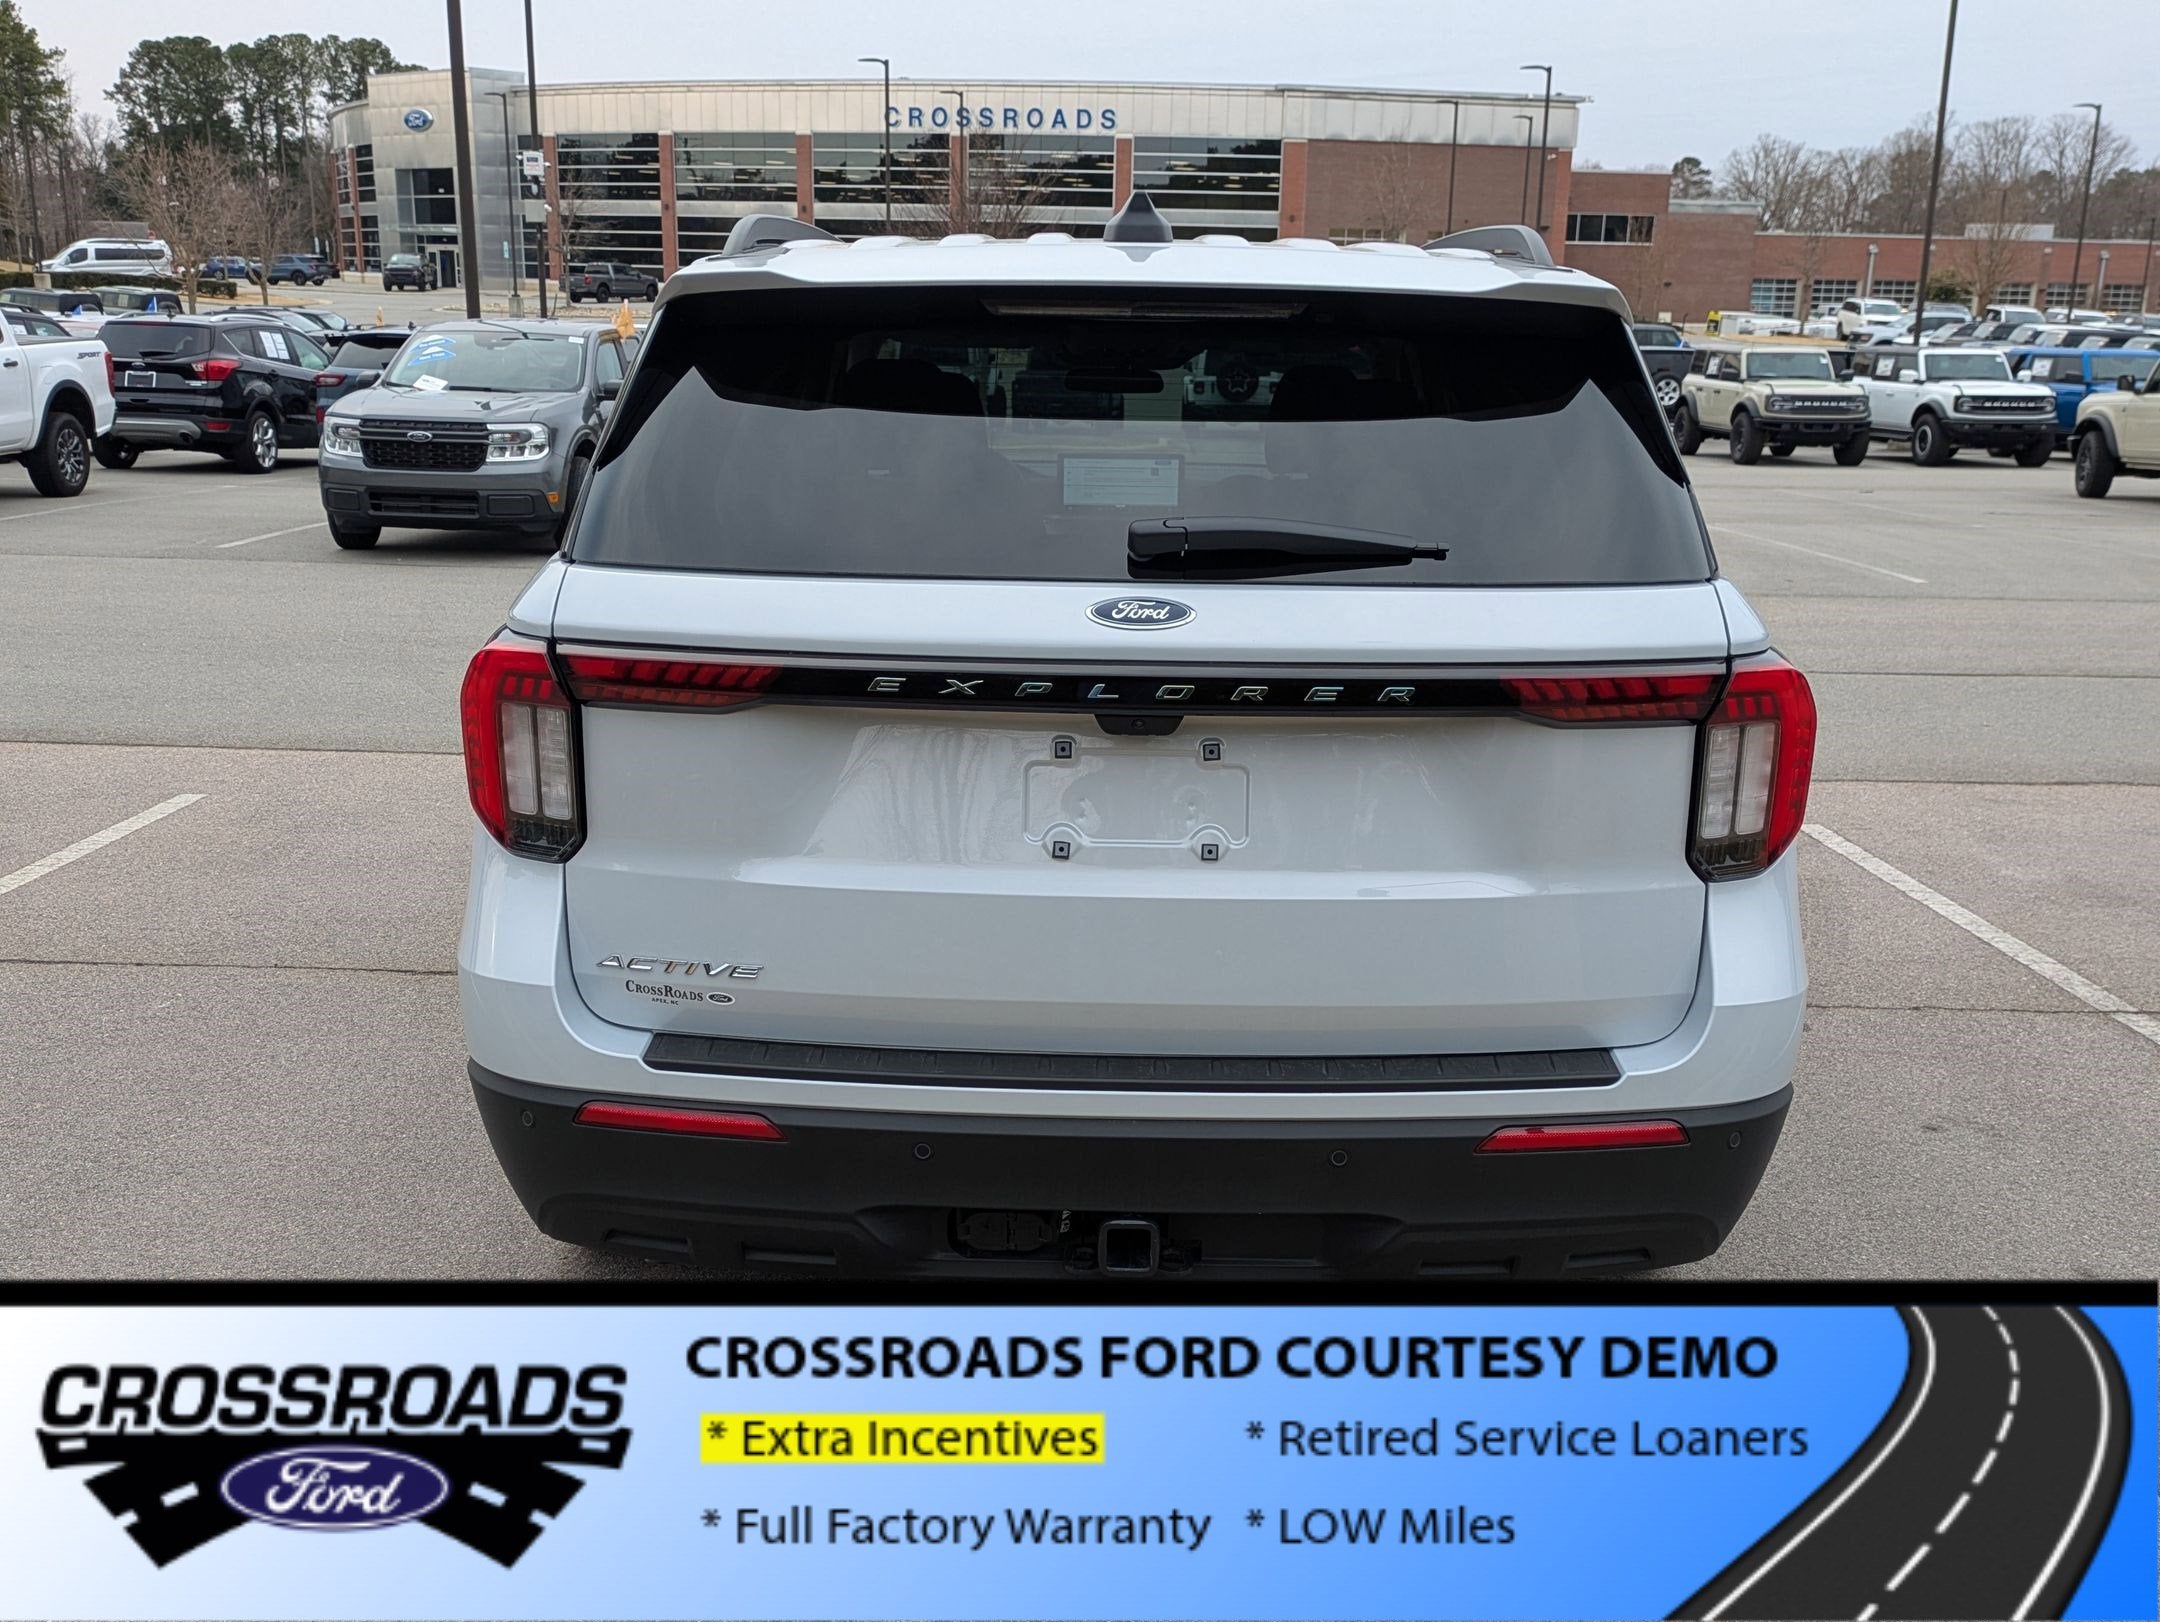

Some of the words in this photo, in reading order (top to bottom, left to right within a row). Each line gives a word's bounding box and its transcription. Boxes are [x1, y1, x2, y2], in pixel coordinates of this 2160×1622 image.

[885, 106, 1117, 130] CROSSROADS
[77, 351, 102, 360] SPORT
[1111, 600, 1171, 619] Ford
[867, 676, 1417, 702] EXPLORER
[597, 953, 765, 980] ACTIVE
